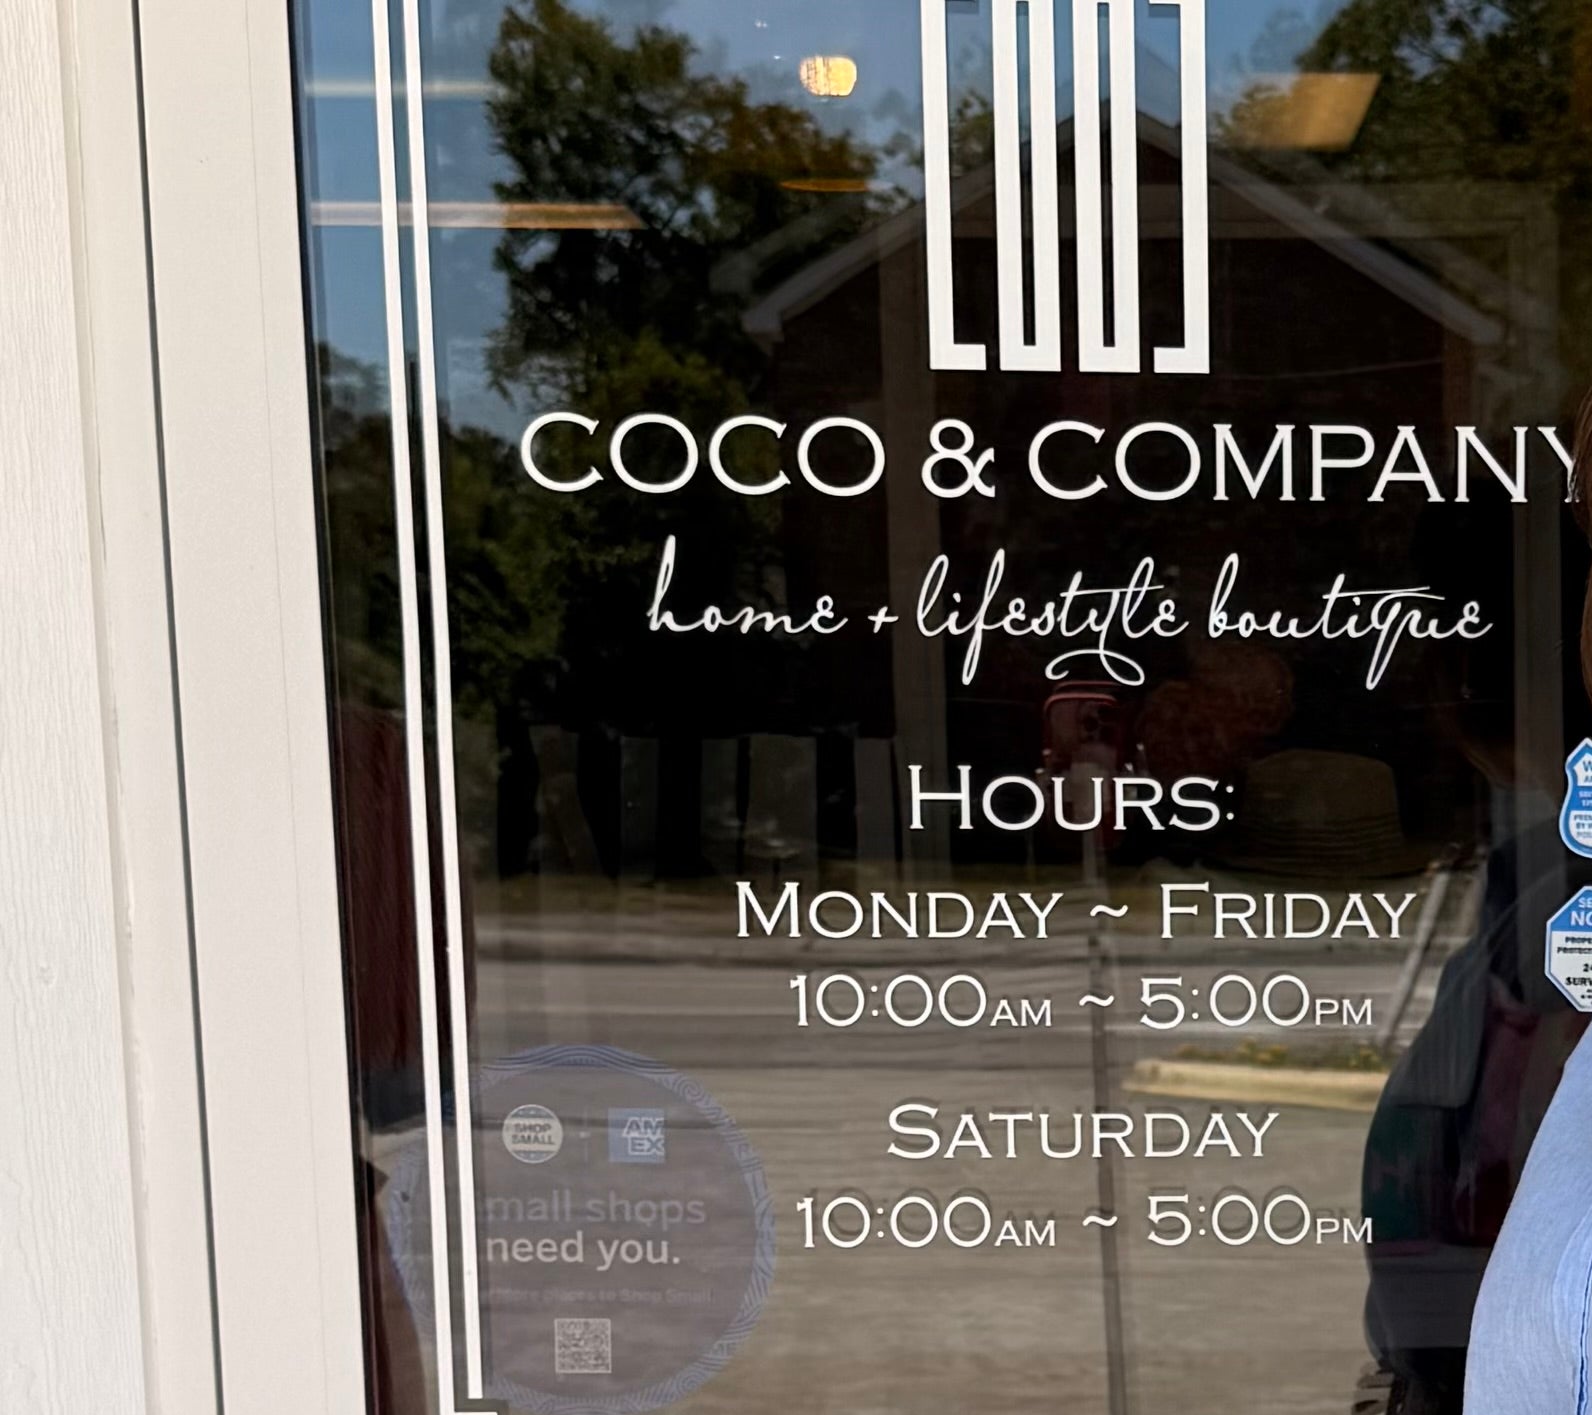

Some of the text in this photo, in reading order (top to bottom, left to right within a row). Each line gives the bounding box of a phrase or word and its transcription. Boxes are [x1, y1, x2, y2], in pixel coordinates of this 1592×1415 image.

[519, 412, 1580, 504] COCO & COMPANY
[647, 534, 1493, 691] home + lifestyle boutique
[908, 764, 1235, 832] HOURS:
[736, 880, 1064, 940] MONDAY
[1160, 881, 1417, 940] FRIDAY
[789, 974, 1053, 1028] 10:00AM
[1139, 973, 1374, 1030] 5:00PM
[511, 1134, 555, 1145] SMALL
[514, 1122, 552, 1133] SHOP
[886, 1102, 1280, 1160] SATURDAY
[487, 1188, 705, 1231] mall shops
[795, 1195, 1056, 1249] 10:00AM
[1146, 1193, 1374, 1247] 5:00PM
[487, 1229, 680, 1271] need you.
